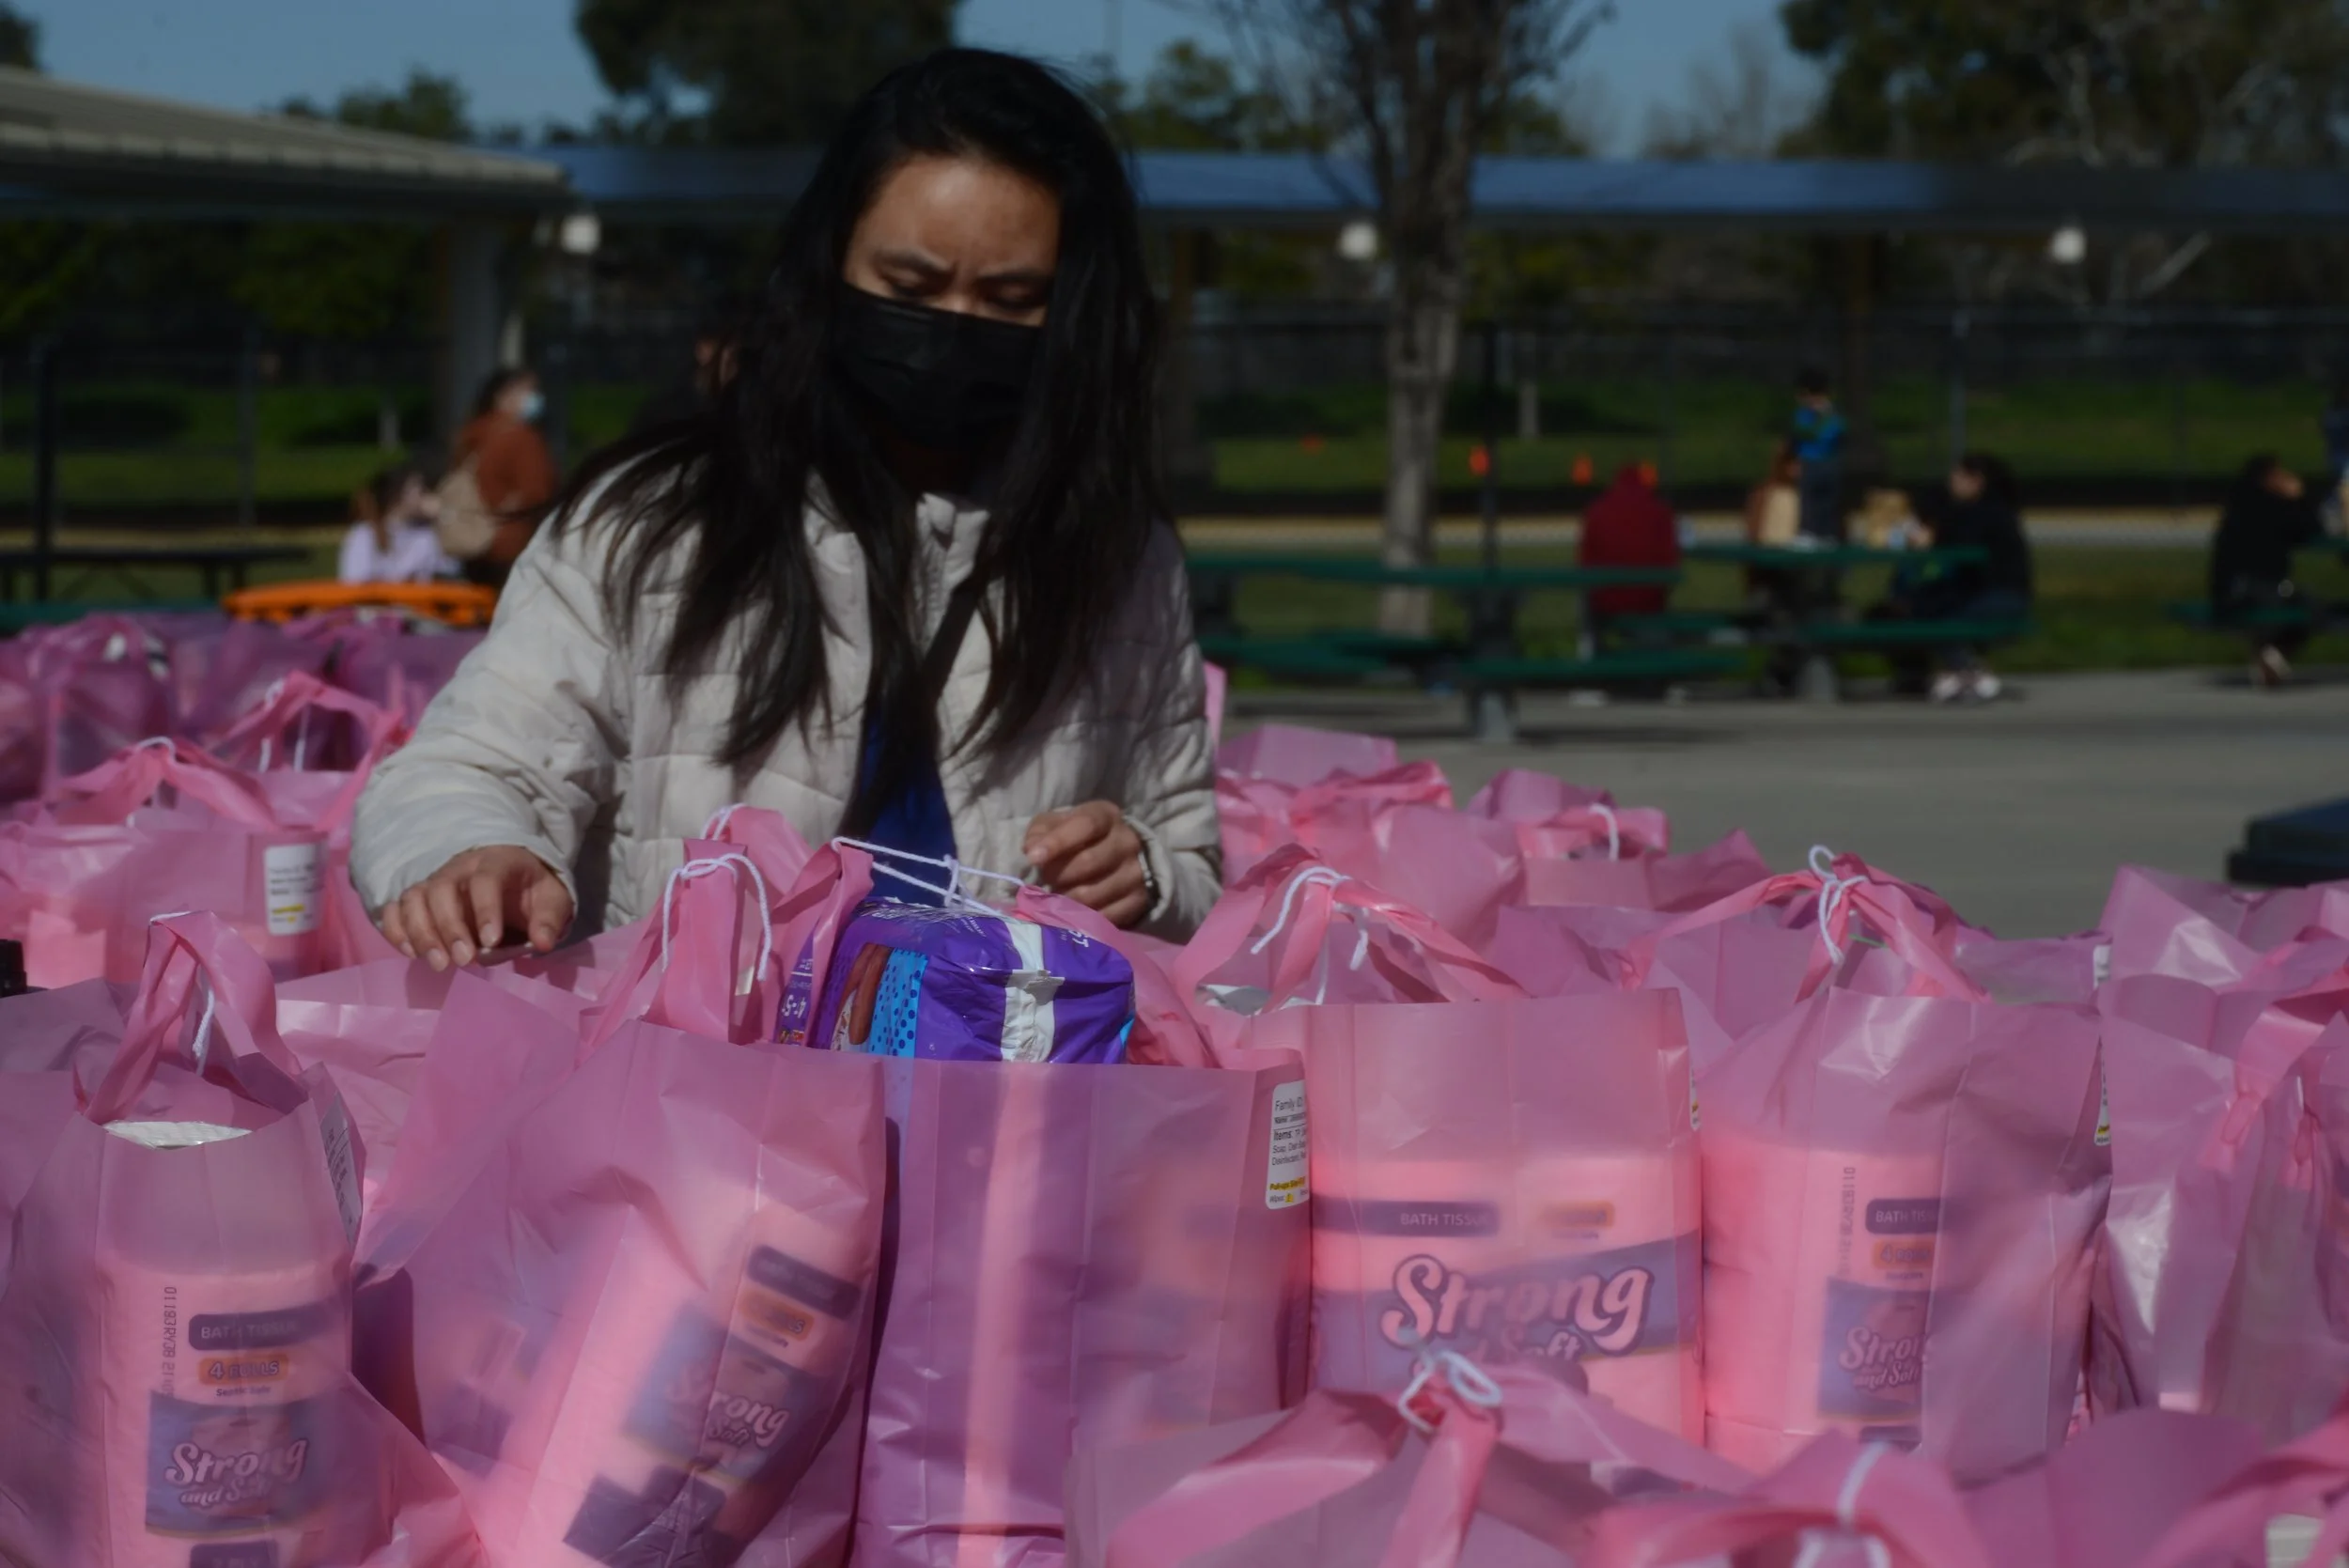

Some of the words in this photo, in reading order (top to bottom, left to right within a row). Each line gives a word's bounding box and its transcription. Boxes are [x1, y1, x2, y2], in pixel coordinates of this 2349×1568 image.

[1275, 1098, 1296, 1111] Family
[1400, 1213, 1439, 1226] BATH
[1875, 1209, 1908, 1224] BATH
[1379, 1253, 1655, 1356] Strong
[200, 1324, 242, 1340] BATH
[209, 1360, 226, 1380] 4
[164, 1437, 310, 1486] Strong
[179, 1485, 224, 1508] and
